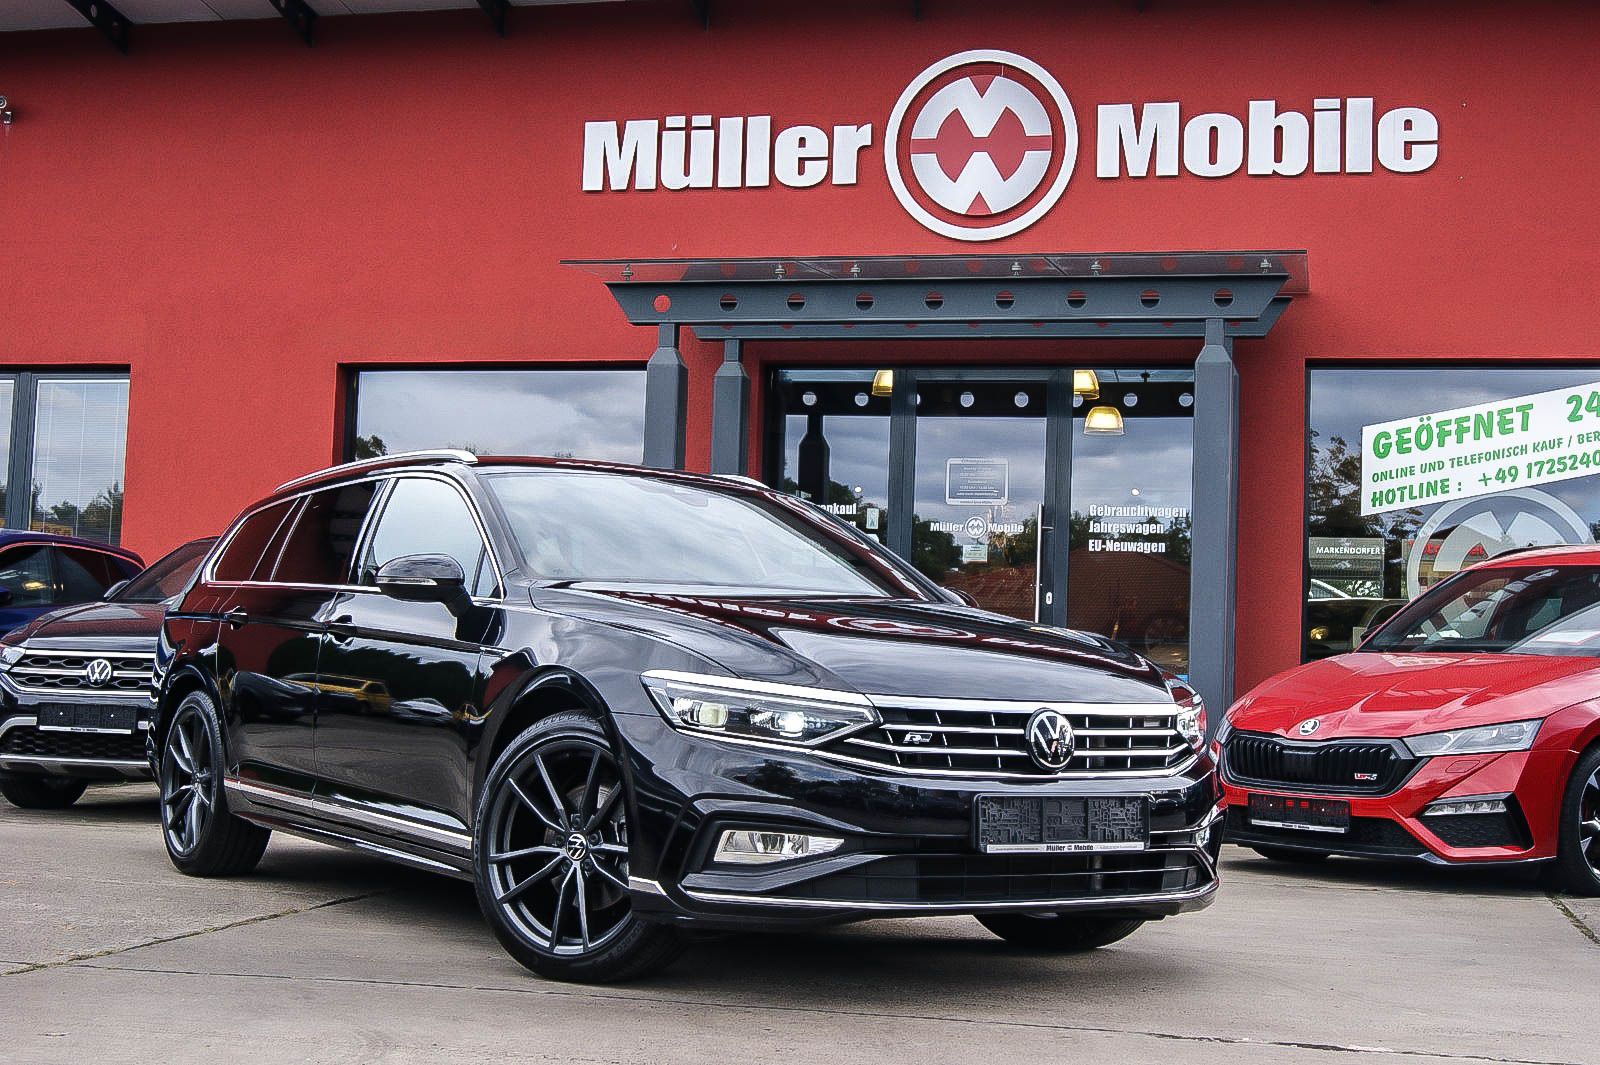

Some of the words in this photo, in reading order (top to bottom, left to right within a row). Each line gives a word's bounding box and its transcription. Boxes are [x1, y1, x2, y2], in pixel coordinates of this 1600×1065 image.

[582, 115, 872, 191] Müller
[1096, 97, 1439, 178] Mobile
[1372, 403, 1534, 459] GEÖFFNET
[1371, 465, 1416, 483] ONLINE
[1420, 460, 1445, 474] UND
[1448, 443, 1528, 469] TELEFONISCH
[1532, 437, 1564, 453] KAUF
[1370, 477, 1450, 508] HOTLINE
[1477, 465, 1519, 487] +49
[1089, 504, 1187, 518] Gebrauchtwagen
[930, 521, 964, 532] Müller
[988, 522, 1024, 533] Mobile
[1088, 520, 1164, 535] Jahreswagen
[1088, 539, 1166, 553] EU-Neuwagen
[1316, 546, 1380, 555] MARKENDORFER
